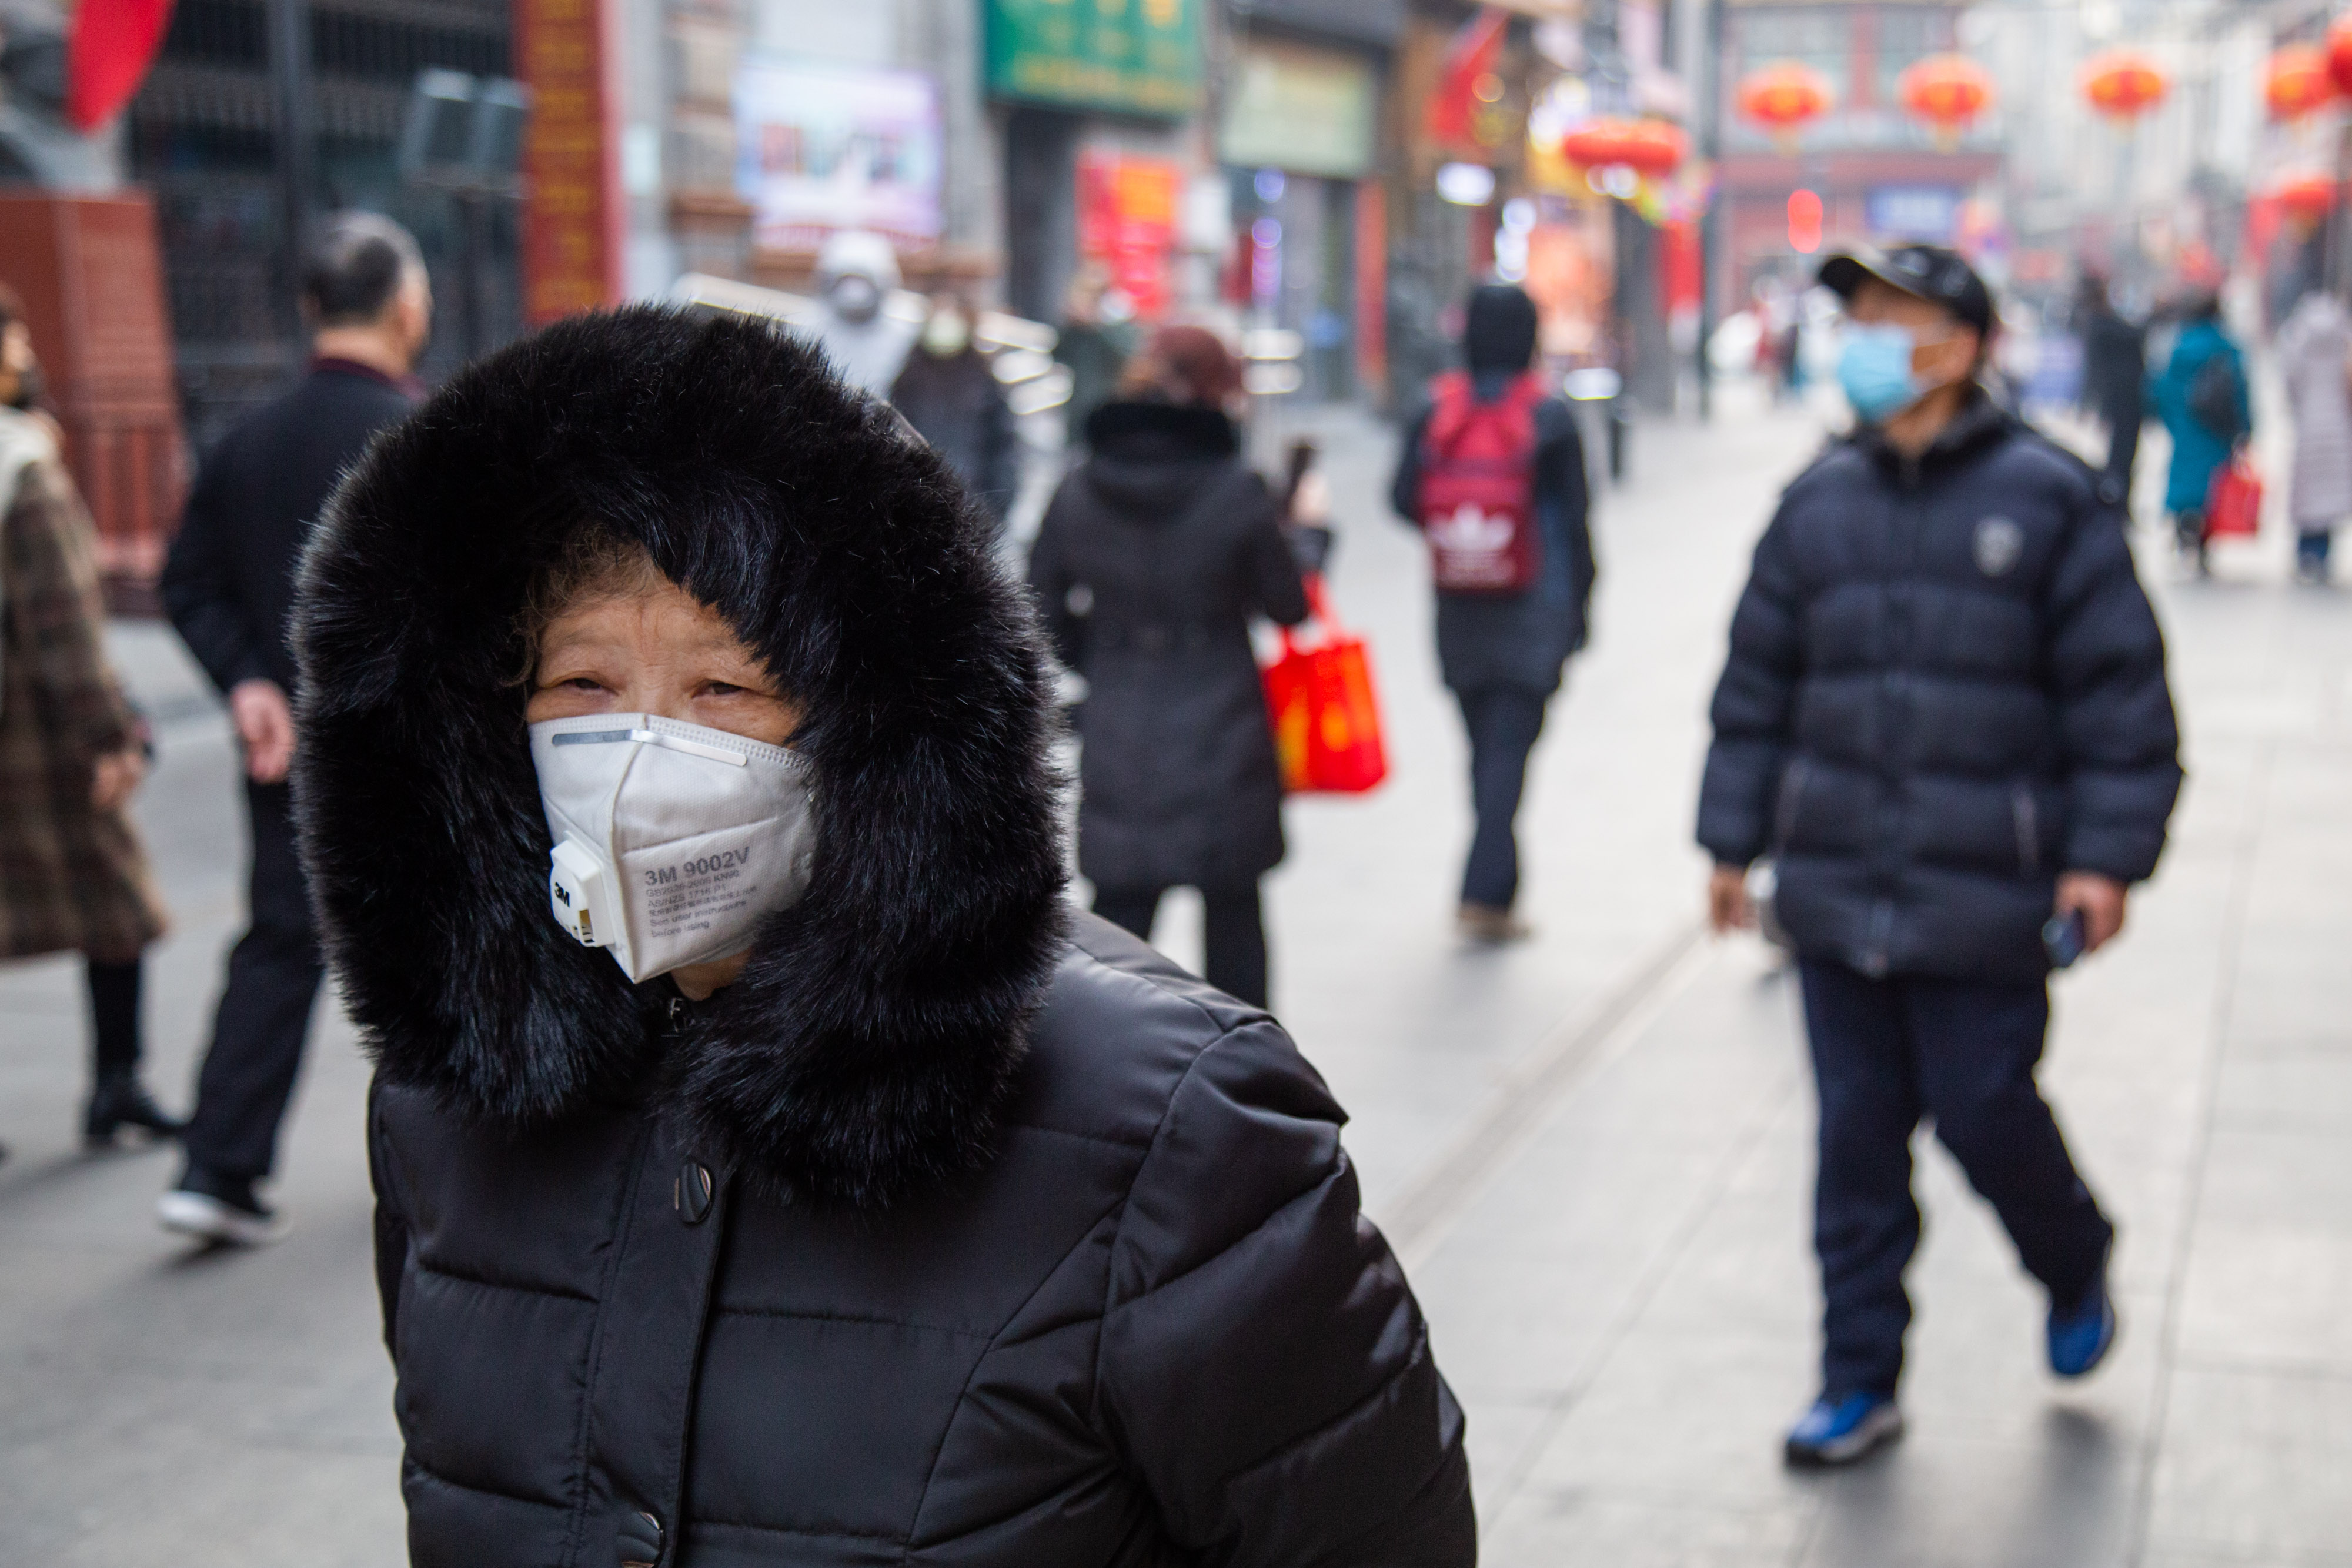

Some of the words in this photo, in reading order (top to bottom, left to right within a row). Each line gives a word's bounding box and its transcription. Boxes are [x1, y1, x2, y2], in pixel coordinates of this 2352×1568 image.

[644, 865, 677, 886] 3M
[683, 846, 750, 878] 9002V
[554, 881, 570, 908] 3M
